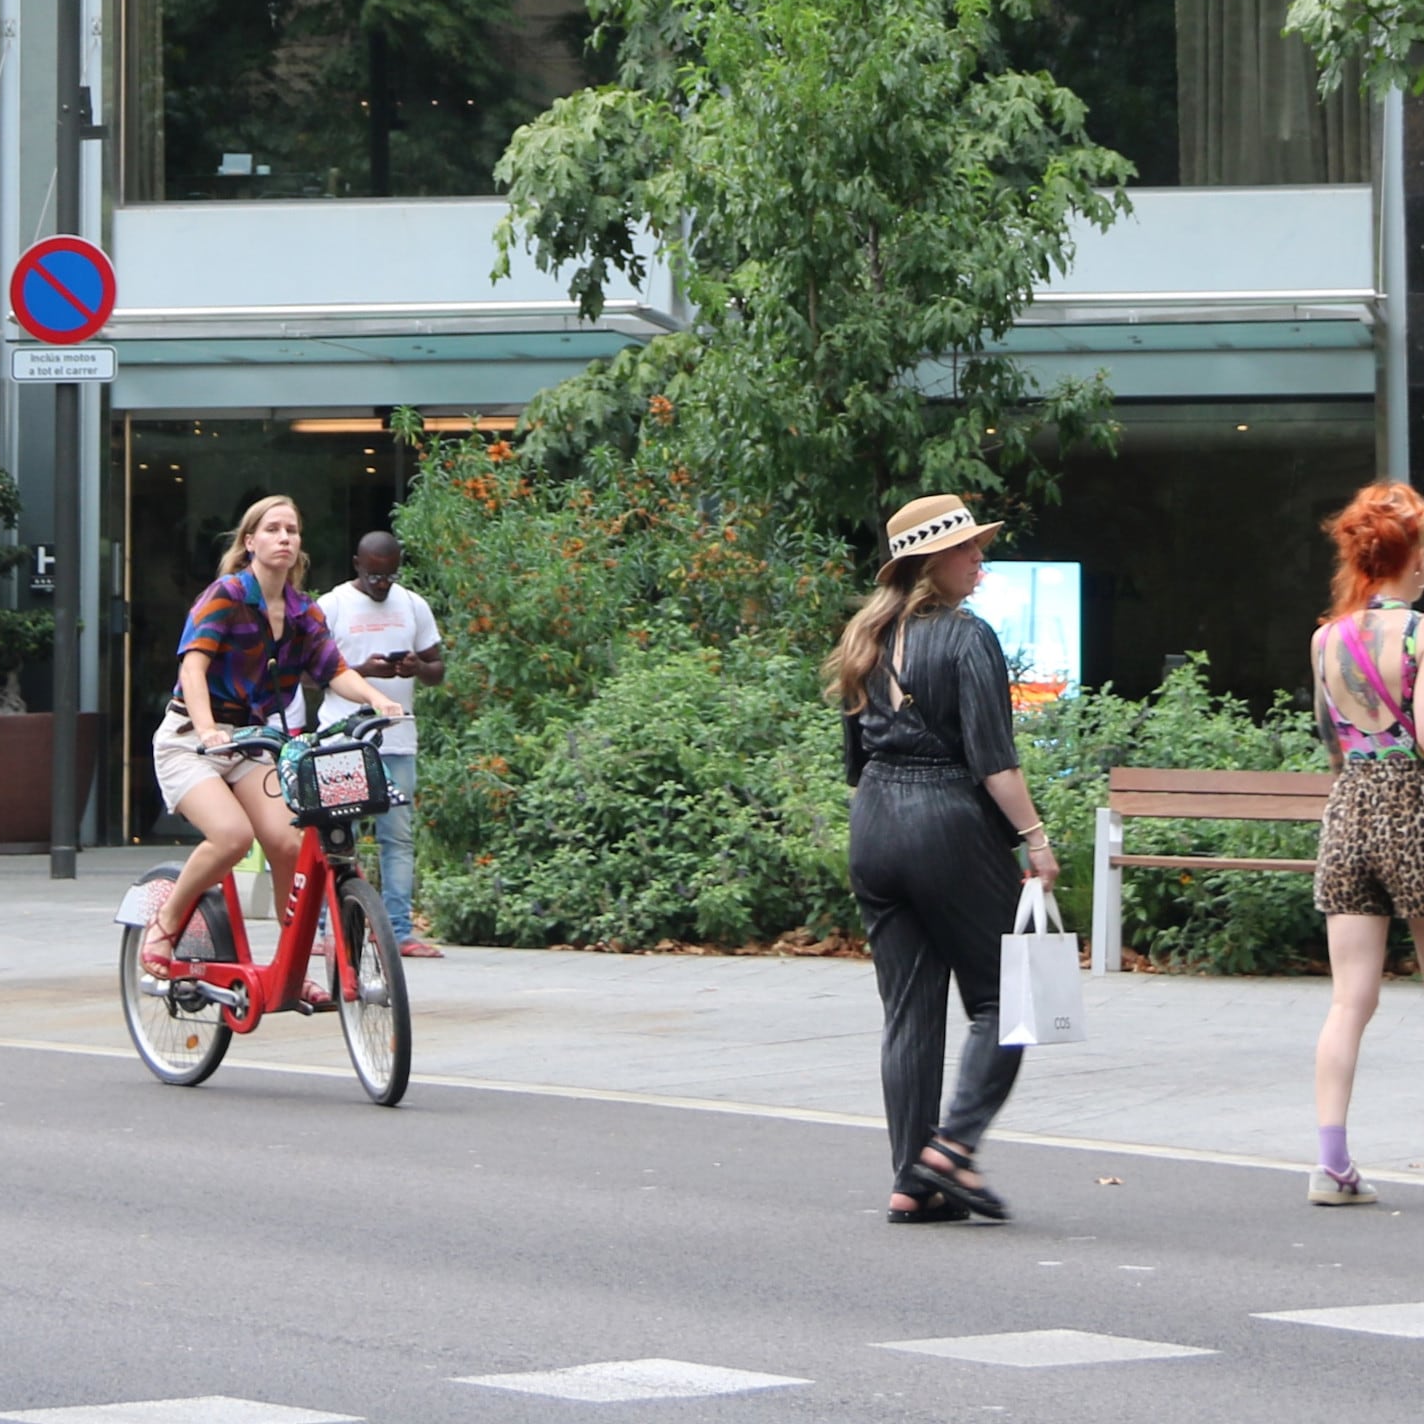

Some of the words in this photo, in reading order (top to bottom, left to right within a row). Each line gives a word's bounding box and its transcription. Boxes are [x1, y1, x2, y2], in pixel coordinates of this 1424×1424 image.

[63, 353, 96, 362] motos
[29, 367, 35, 376] a
[37, 366, 52, 376] tot
[54, 366, 63, 375] el
[65, 367, 98, 375] carrer
[1054, 1017, 1071, 1030] COS
